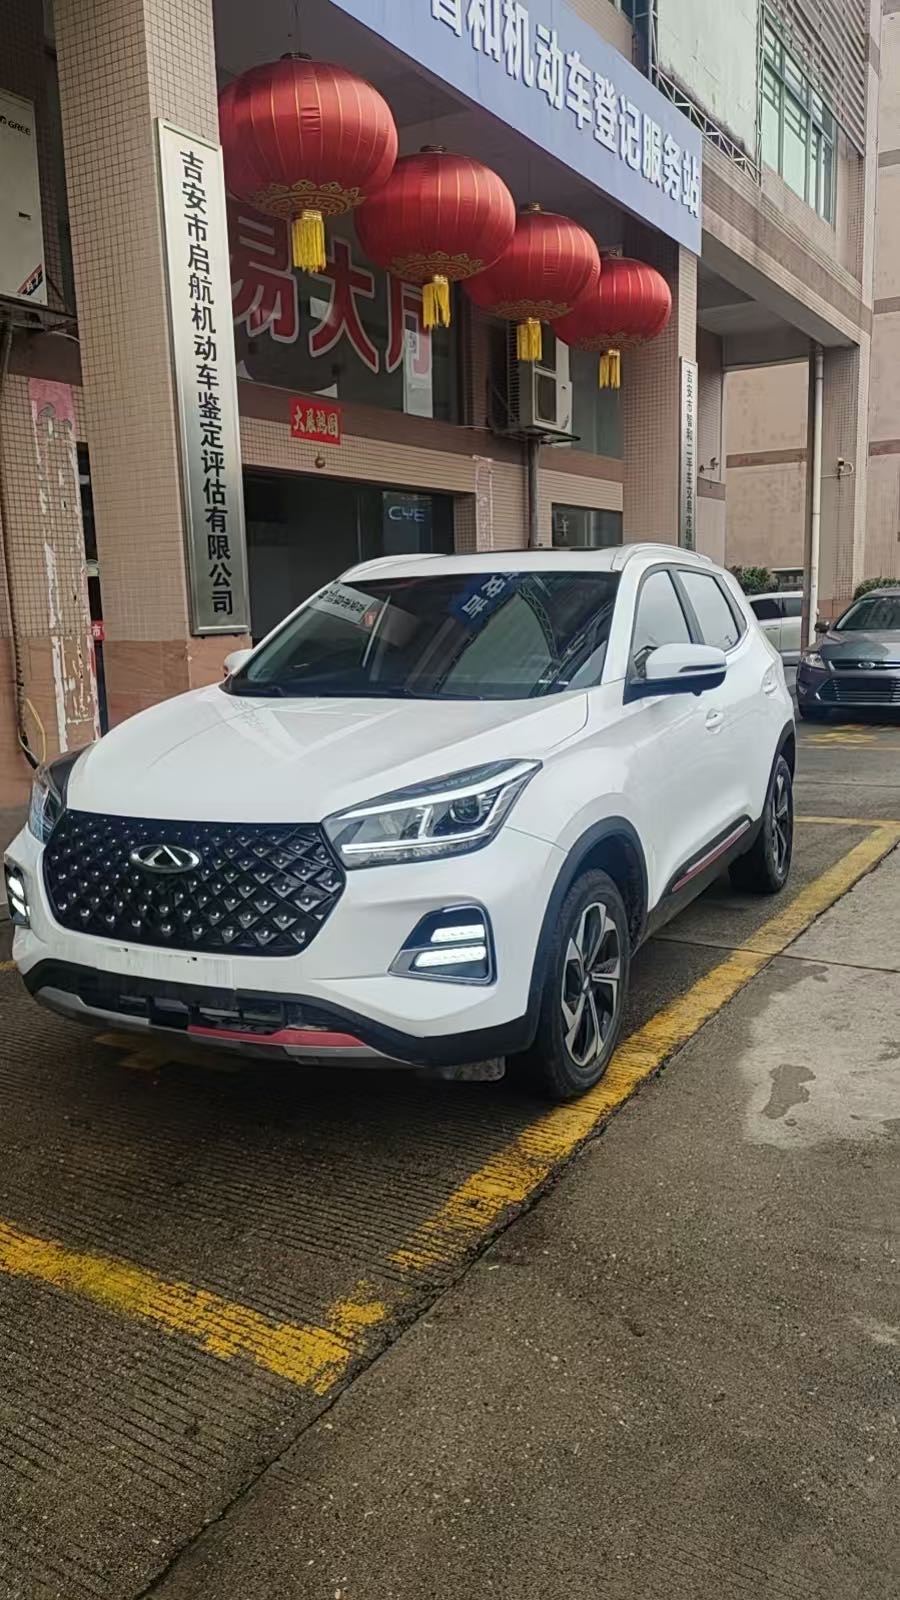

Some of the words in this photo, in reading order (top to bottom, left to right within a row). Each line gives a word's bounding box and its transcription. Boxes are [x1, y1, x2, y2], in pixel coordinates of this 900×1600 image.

[8, 120, 31, 136] GREE
[180, 150, 233, 616] 吉安市启航机动车鉴定评估有限公司
